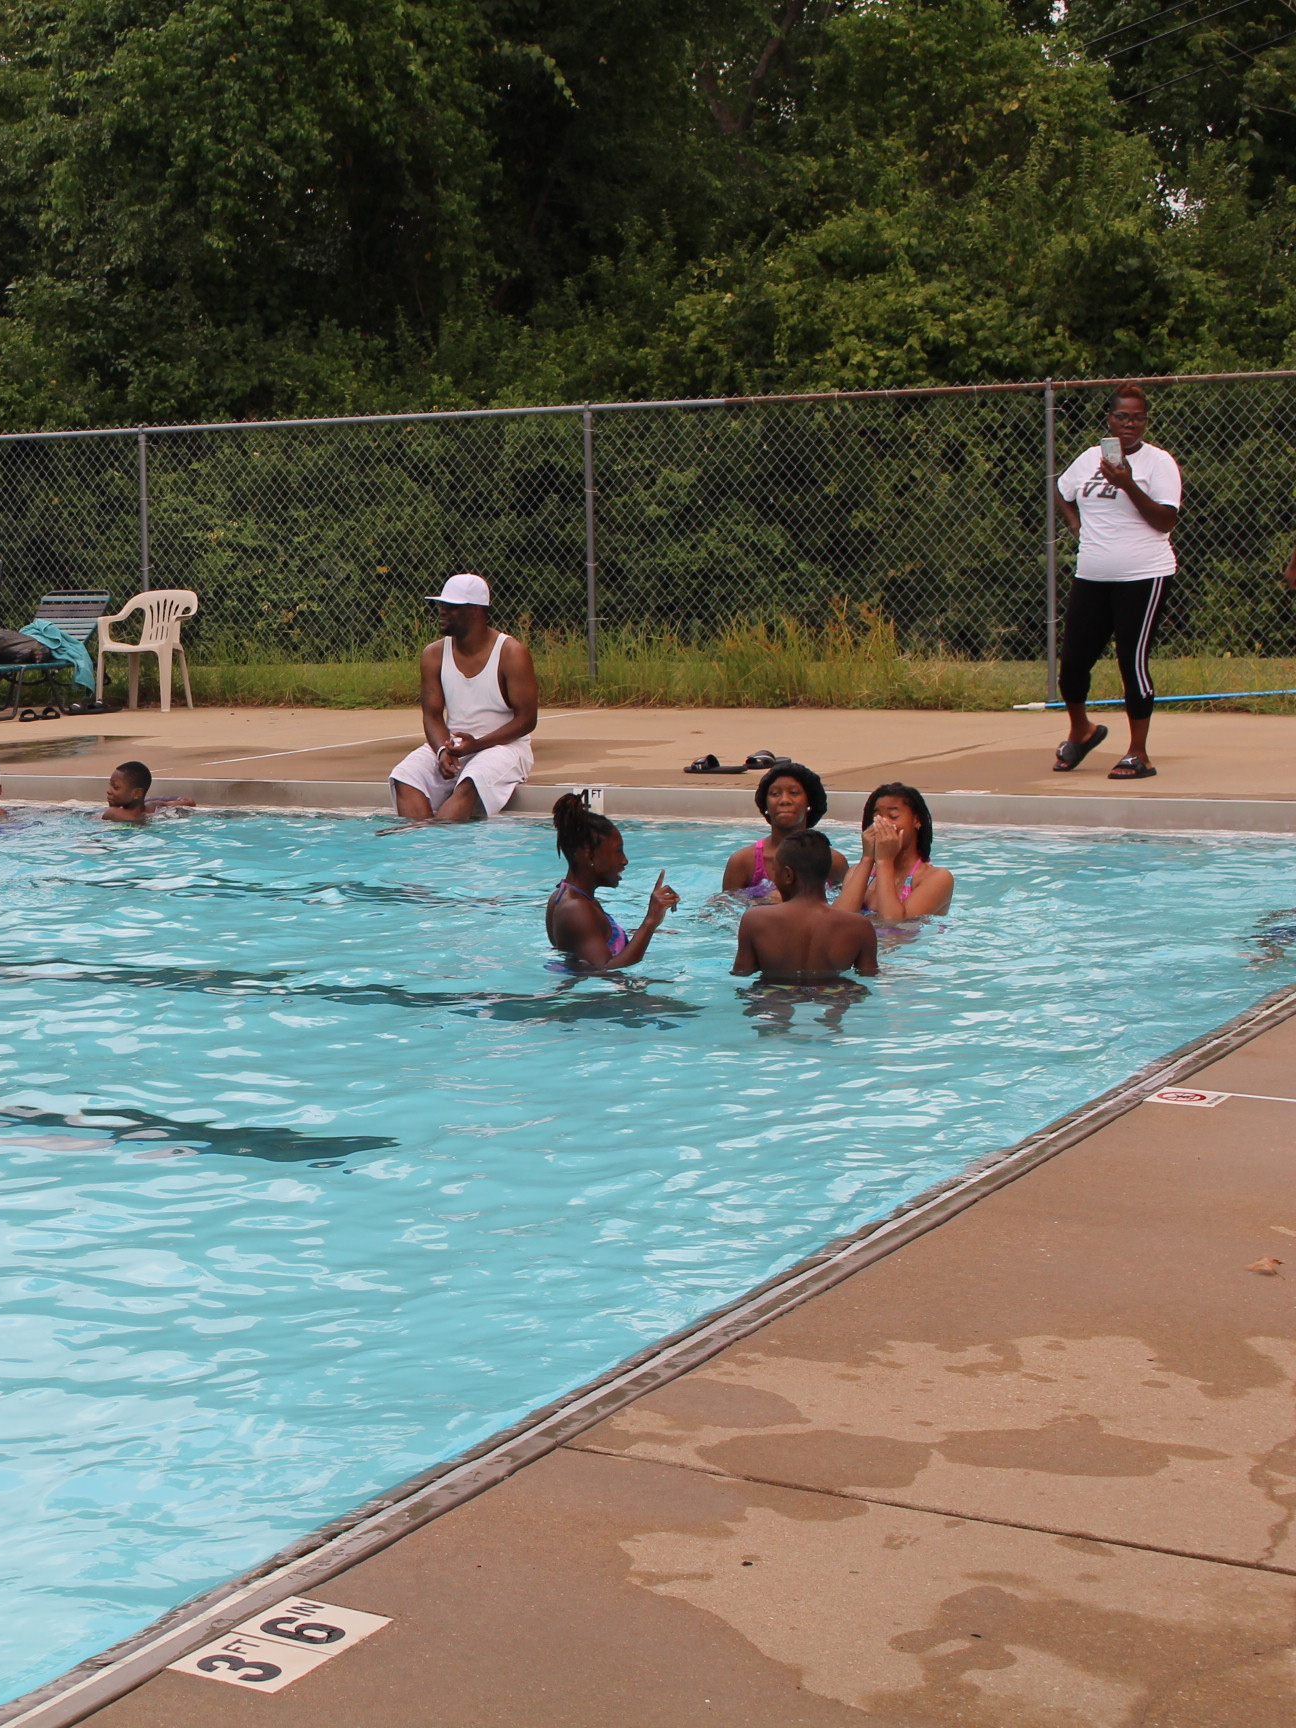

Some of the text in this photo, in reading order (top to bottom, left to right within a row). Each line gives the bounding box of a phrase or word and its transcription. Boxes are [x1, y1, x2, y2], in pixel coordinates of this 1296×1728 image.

[1083, 482, 1118, 499] VE
[591, 789, 602, 798] FT
[197, 1601, 346, 1682] 3 FT 6 IN
